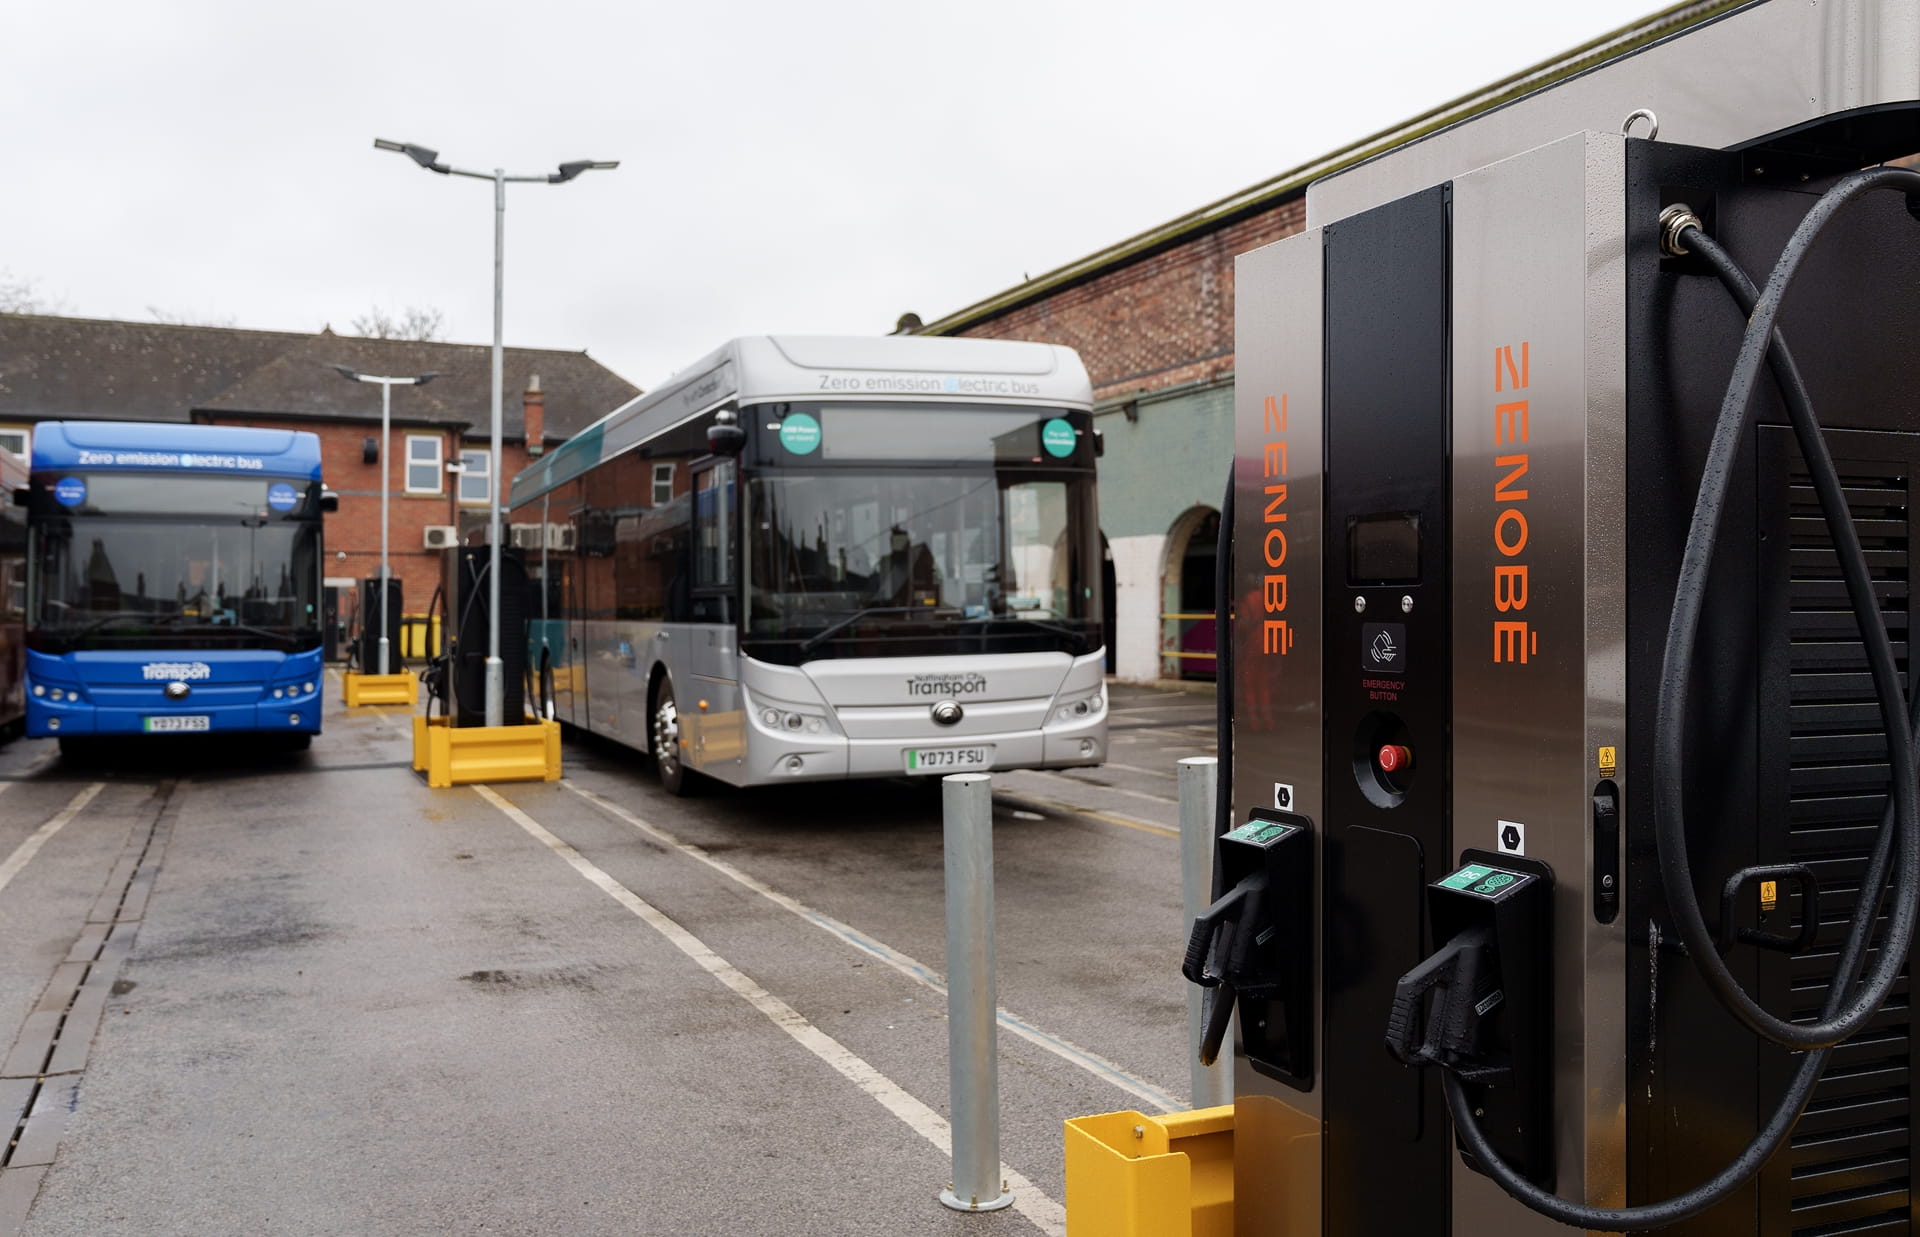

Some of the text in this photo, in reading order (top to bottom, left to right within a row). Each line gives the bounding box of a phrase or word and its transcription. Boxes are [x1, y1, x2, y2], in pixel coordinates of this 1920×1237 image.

[818, 375, 1040, 394] Zero emission electric bus
[79, 450, 263, 470] Zero emission electric bus
[142, 665, 211, 681] Transport
[907, 677, 987, 697] Transport
[1362, 679, 1406, 690] EMERGENCY
[1369, 690, 1398, 701] BUTTON
[920, 749, 984, 765] YD73 FSU
[1508, 832, 1515, 843] L
[1459, 871, 1480, 879] DC
